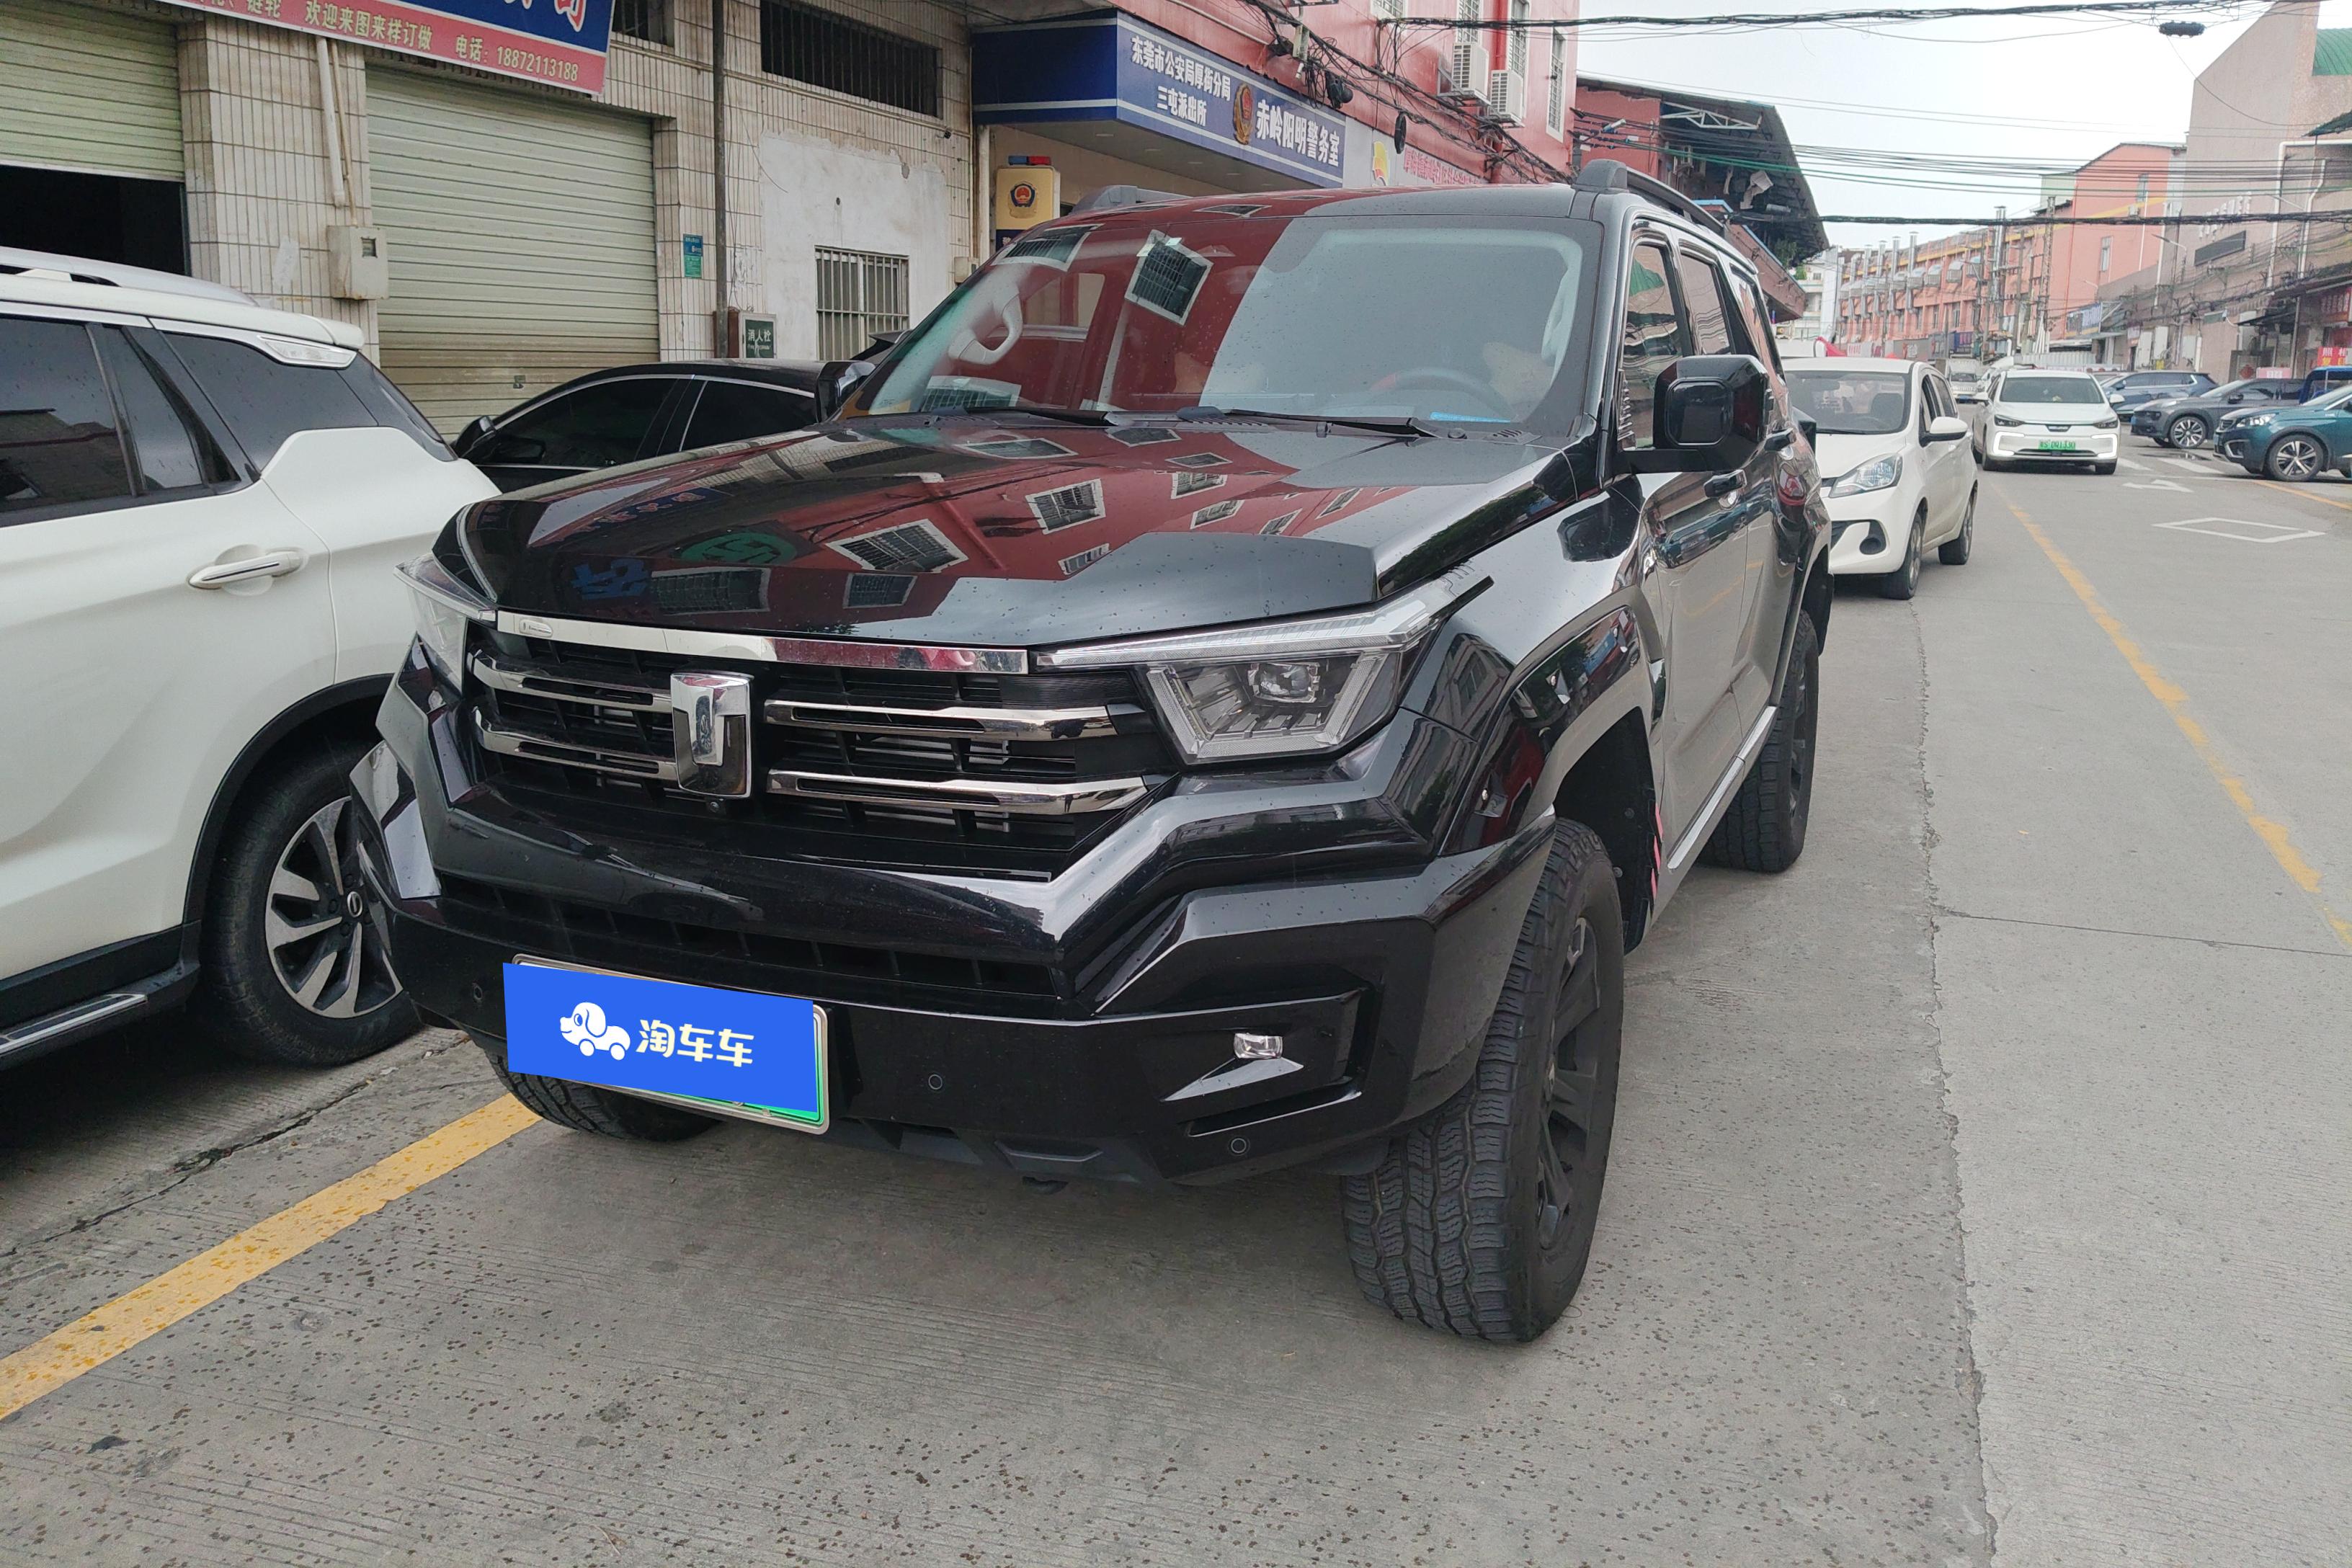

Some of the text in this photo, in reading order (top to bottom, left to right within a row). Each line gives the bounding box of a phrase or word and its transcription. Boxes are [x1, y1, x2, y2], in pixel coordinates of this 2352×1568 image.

[305, 0, 432, 50] 欢迎来图来样订做
[497, 46, 579, 81] 18872113188
[1131, 35, 1231, 101] 东莞市公安局厚街分局
[1157, 85, 1207, 127] 三屯派出所
[1256, 99, 1340, 167] 赤岭阳明警务室
